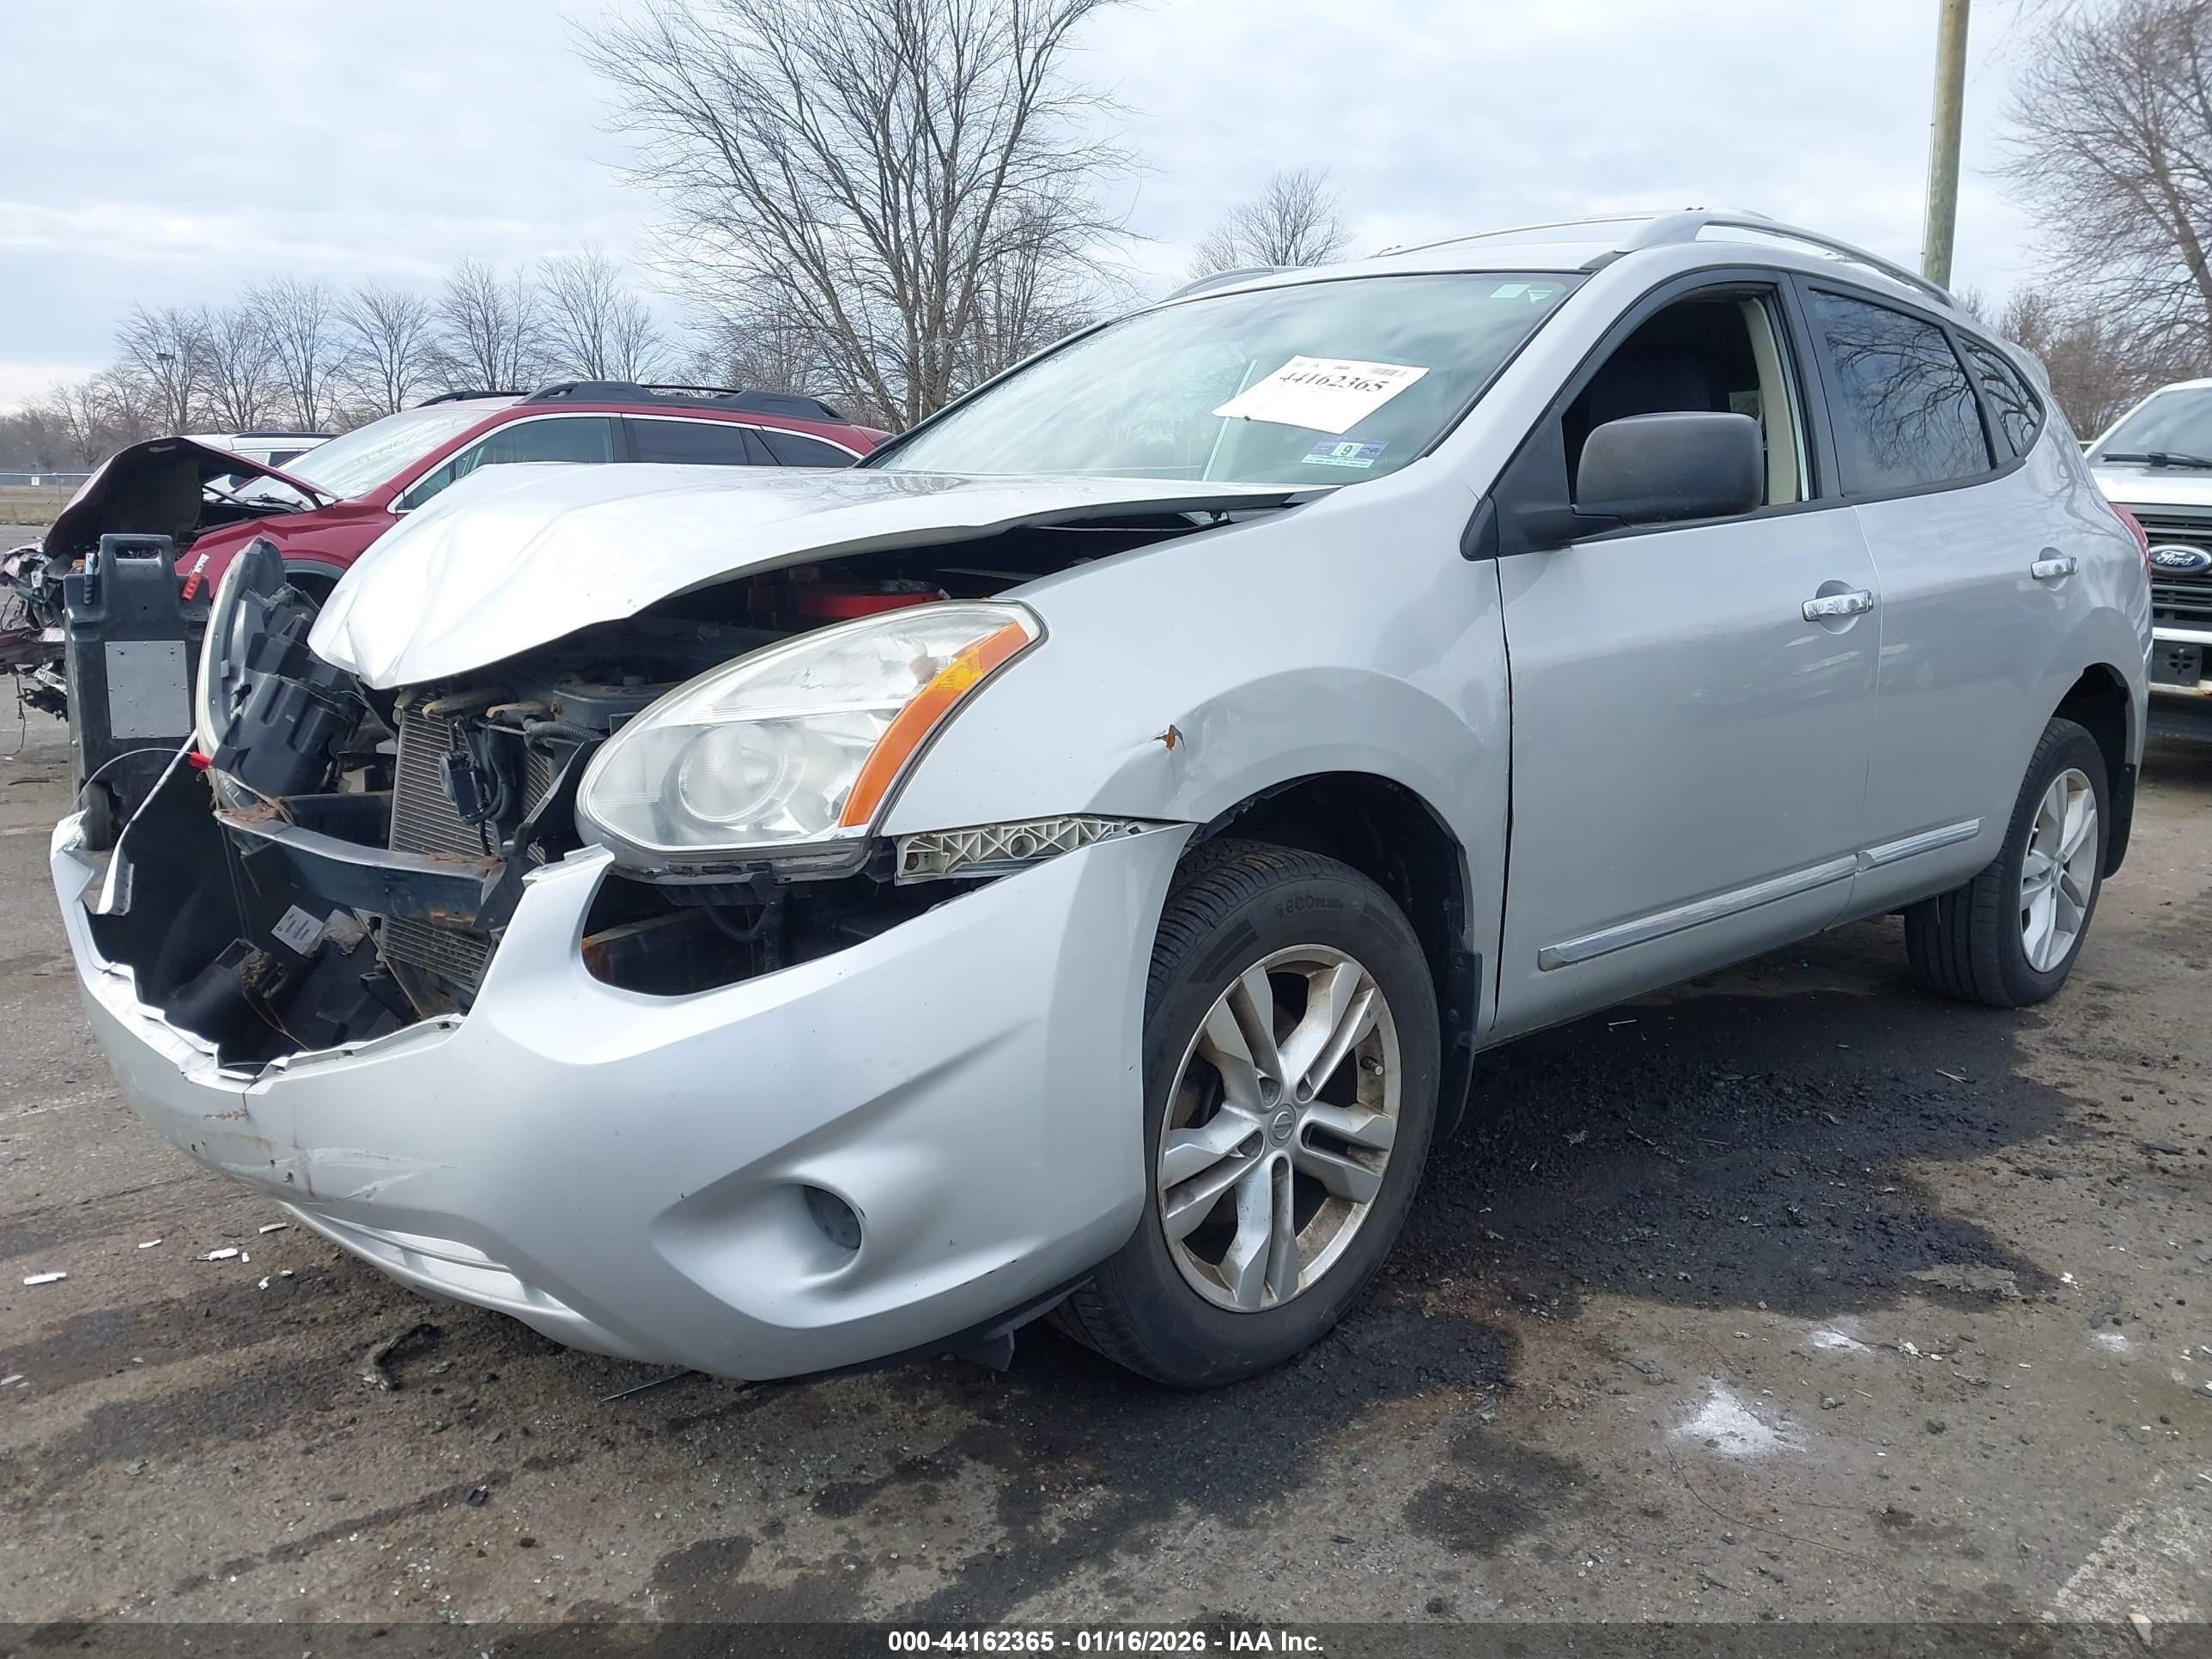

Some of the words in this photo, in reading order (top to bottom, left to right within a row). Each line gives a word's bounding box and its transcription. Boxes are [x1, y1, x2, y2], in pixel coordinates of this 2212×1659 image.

[1279, 372, 1389, 392] 44162365
[1340, 445, 1353, 456] 9
[2157, 551, 2195, 566] Ford
